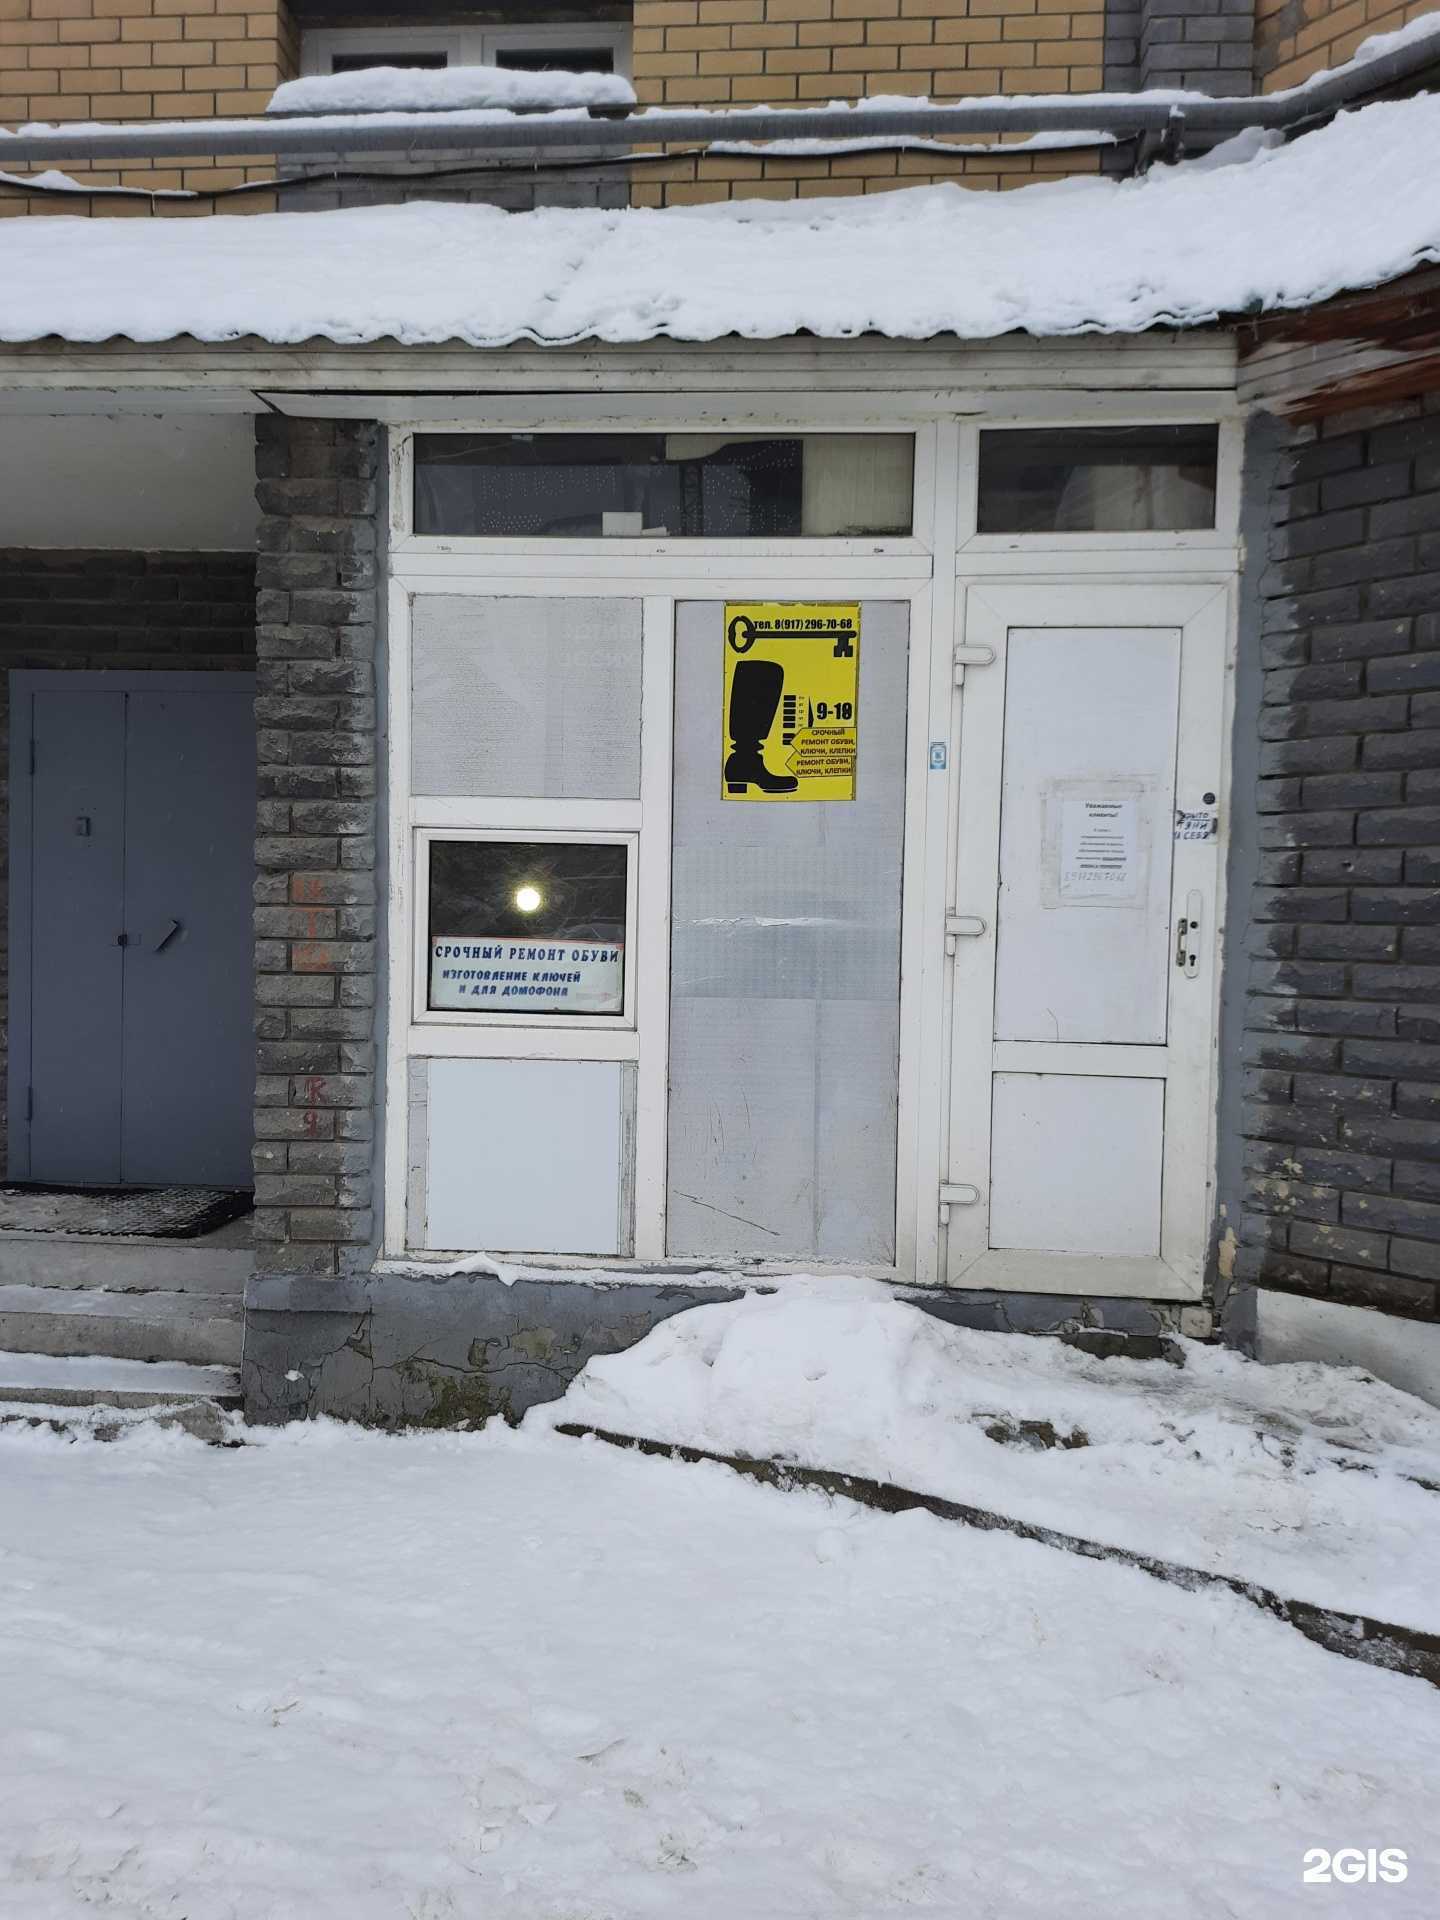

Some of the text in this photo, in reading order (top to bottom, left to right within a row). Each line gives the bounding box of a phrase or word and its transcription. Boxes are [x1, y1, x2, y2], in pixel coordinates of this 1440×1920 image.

[775, 619, 803, 631] 8(917)
[805, 618, 853, 630] 296-70-68
[811, 728, 845, 736] СРОЧНЫЙ
[435, 945, 620, 963] СРОЧНЫЙ РЕМОНТ ОБУВИ
[442, 969, 581, 983] ИЗГОТОВЛЕНИЕ КЛЮЧЕЙ
[471, 985, 496, 996] ДЛЯ
[501, 985, 569, 997] ДОМОФОНА
